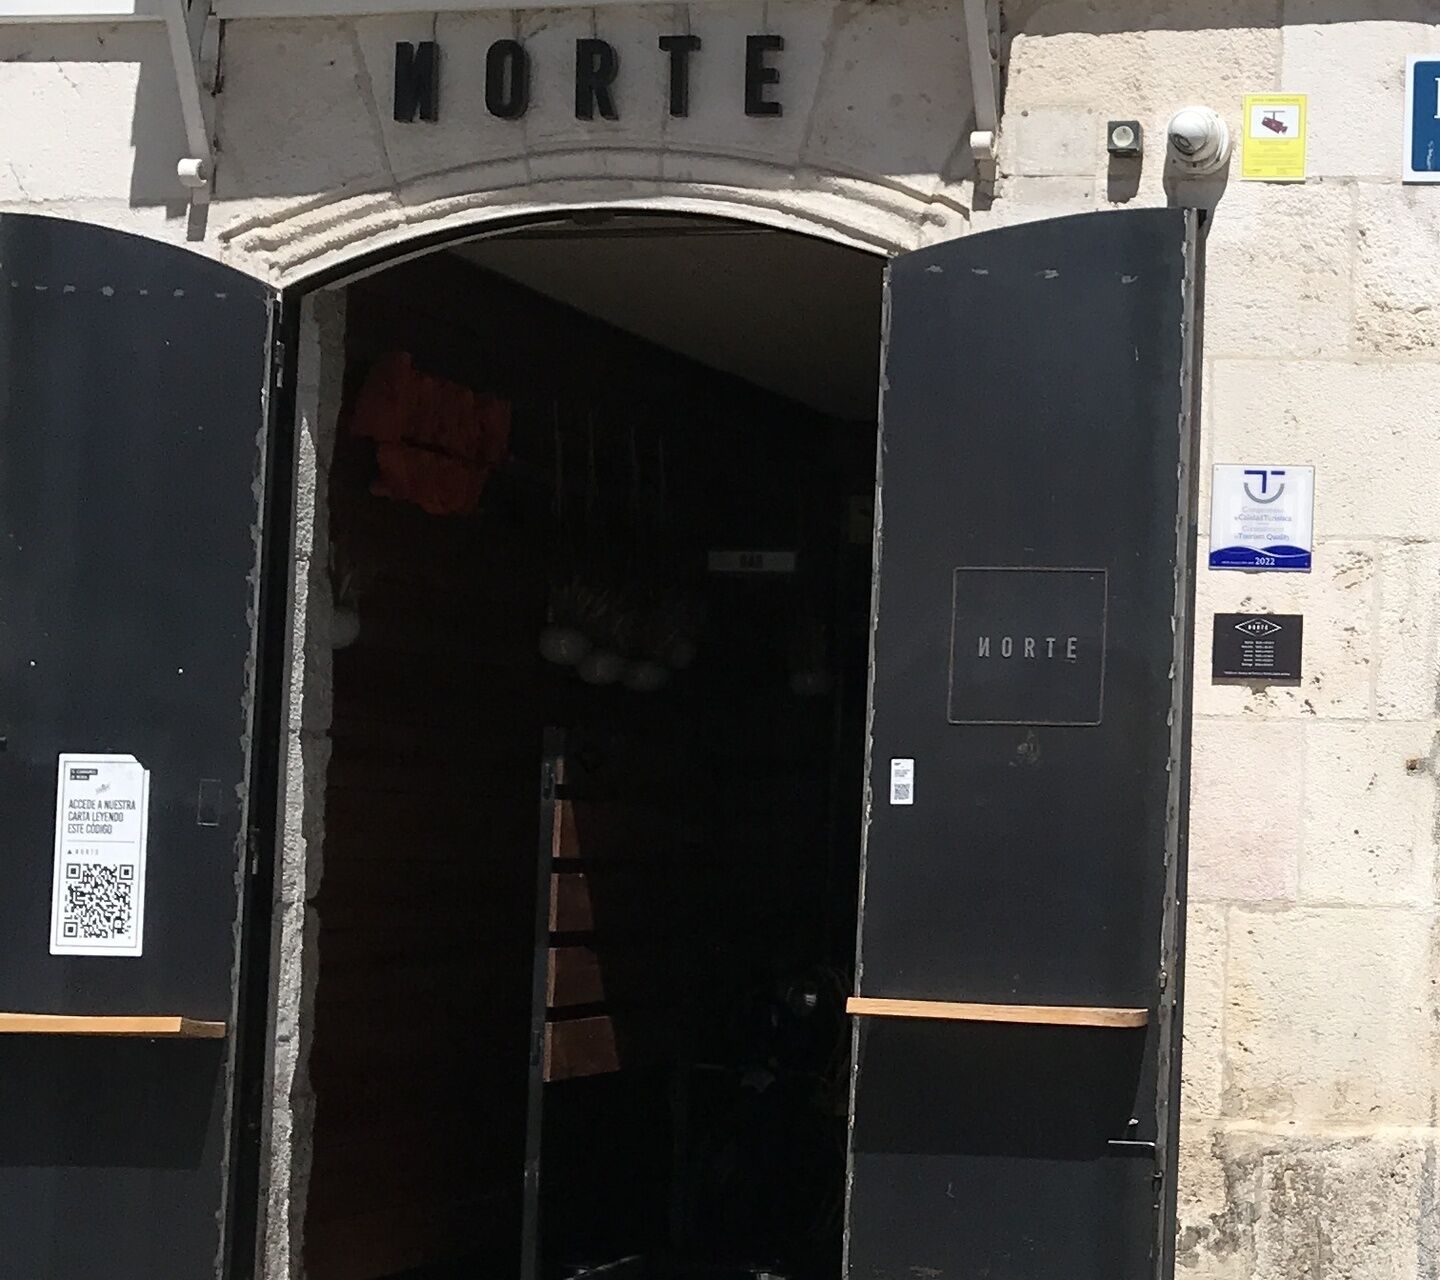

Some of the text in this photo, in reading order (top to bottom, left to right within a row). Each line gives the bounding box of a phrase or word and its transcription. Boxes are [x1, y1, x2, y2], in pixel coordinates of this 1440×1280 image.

[394, 34, 784, 122] NORTE
[1255, 557, 1275, 565] 2022
[979, 637, 1077, 658] NORTE
[69, 799, 136, 810] ACCEDE A NUESTRA
[68, 811, 123, 822] CARTA LEYENDO
[68, 823, 83, 834] ESTE
